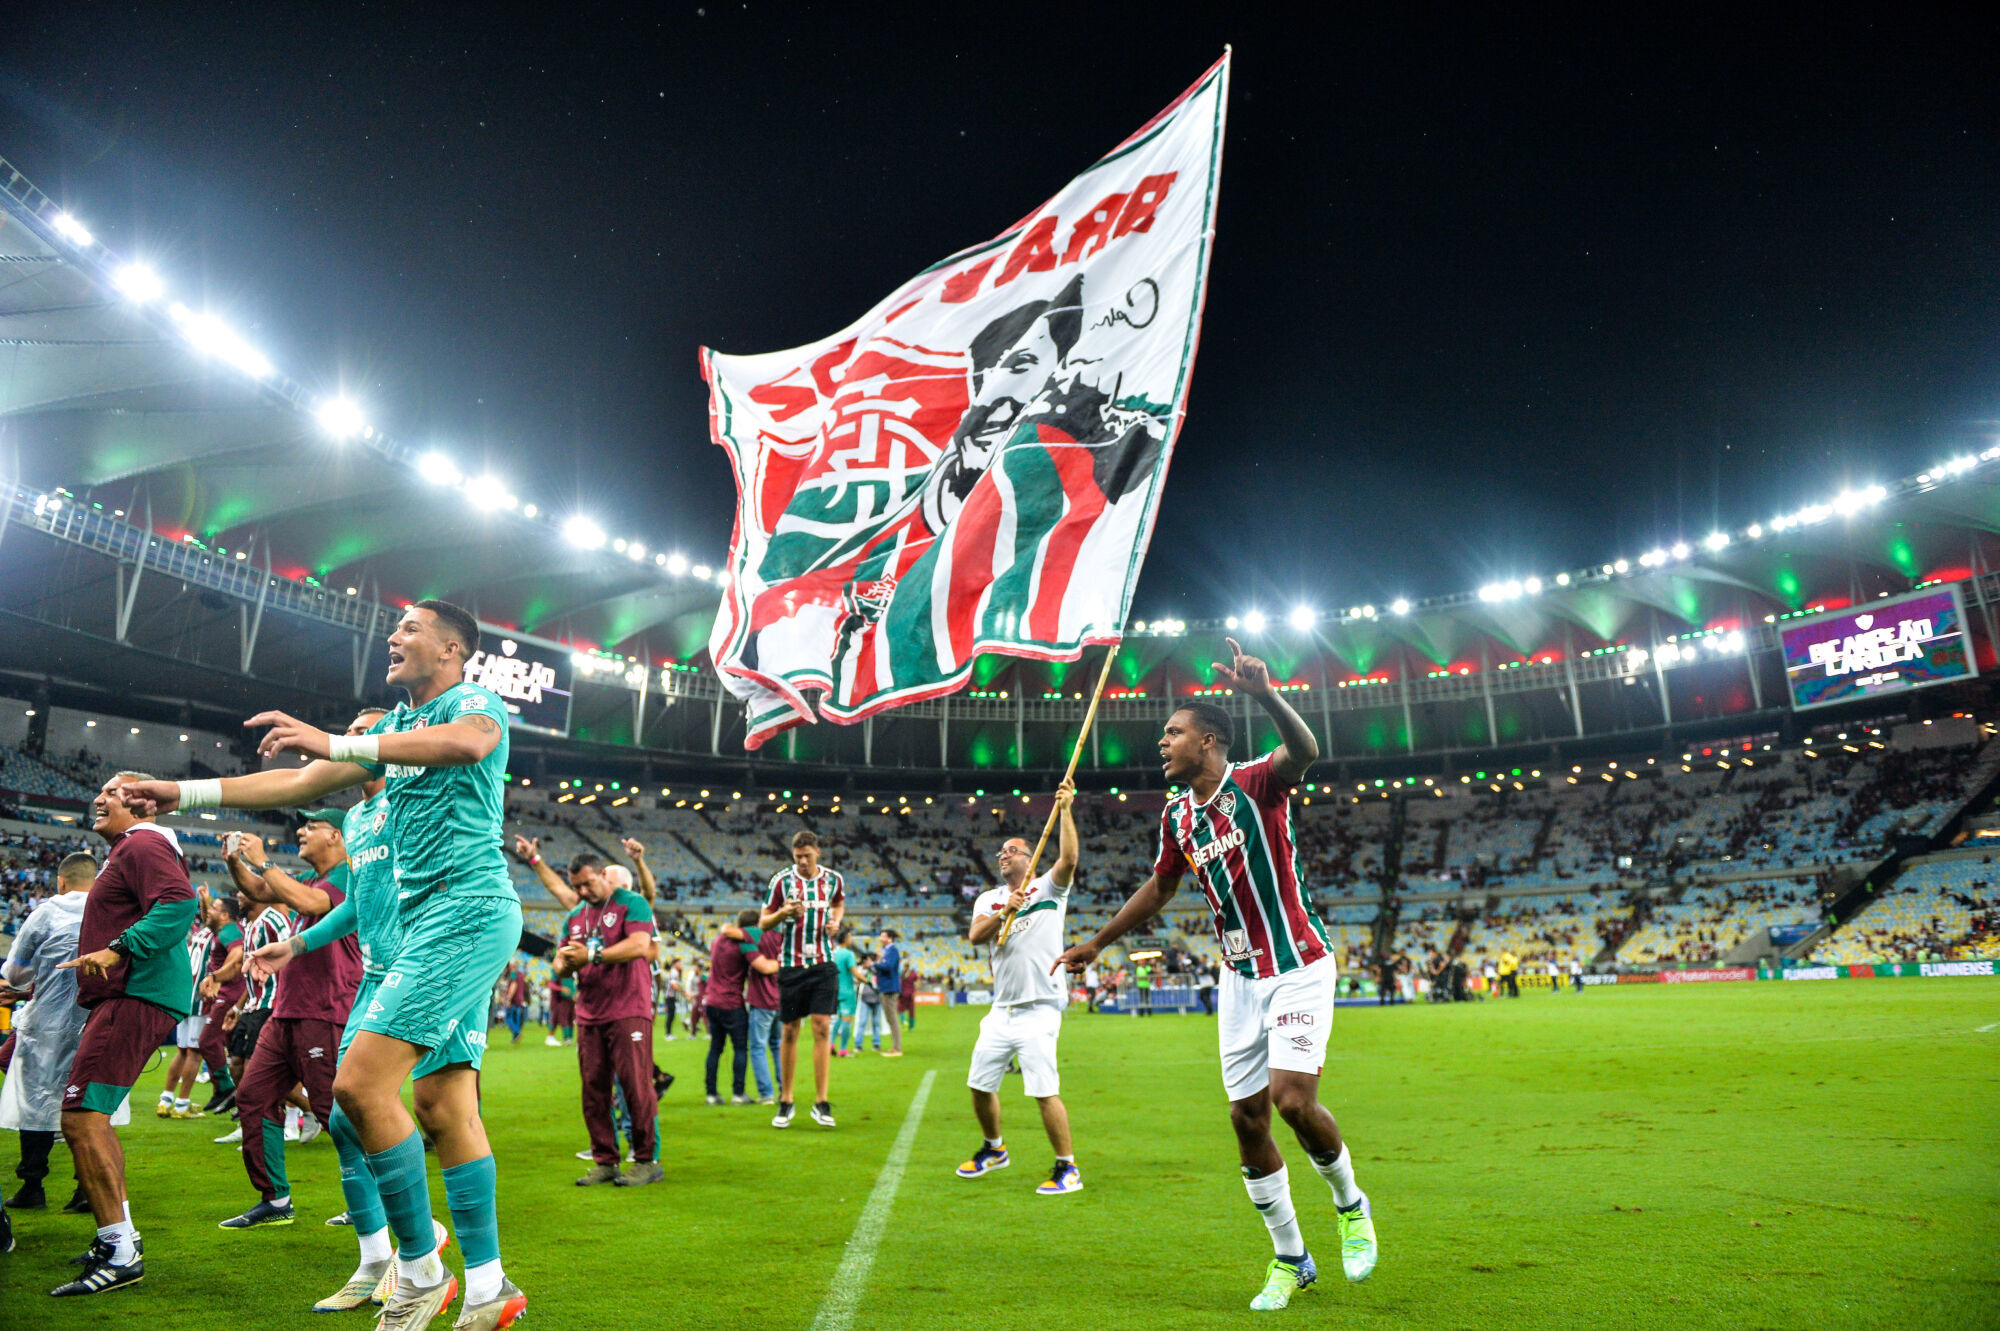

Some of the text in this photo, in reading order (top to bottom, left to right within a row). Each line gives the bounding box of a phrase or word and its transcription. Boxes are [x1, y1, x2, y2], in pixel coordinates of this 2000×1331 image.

[351, 845, 389, 867] BETANO
[1192, 828, 1245, 868] BETANO
[1920, 961, 1994, 976] FLUMINENSE
[1290, 1013, 1314, 1026] HCI
